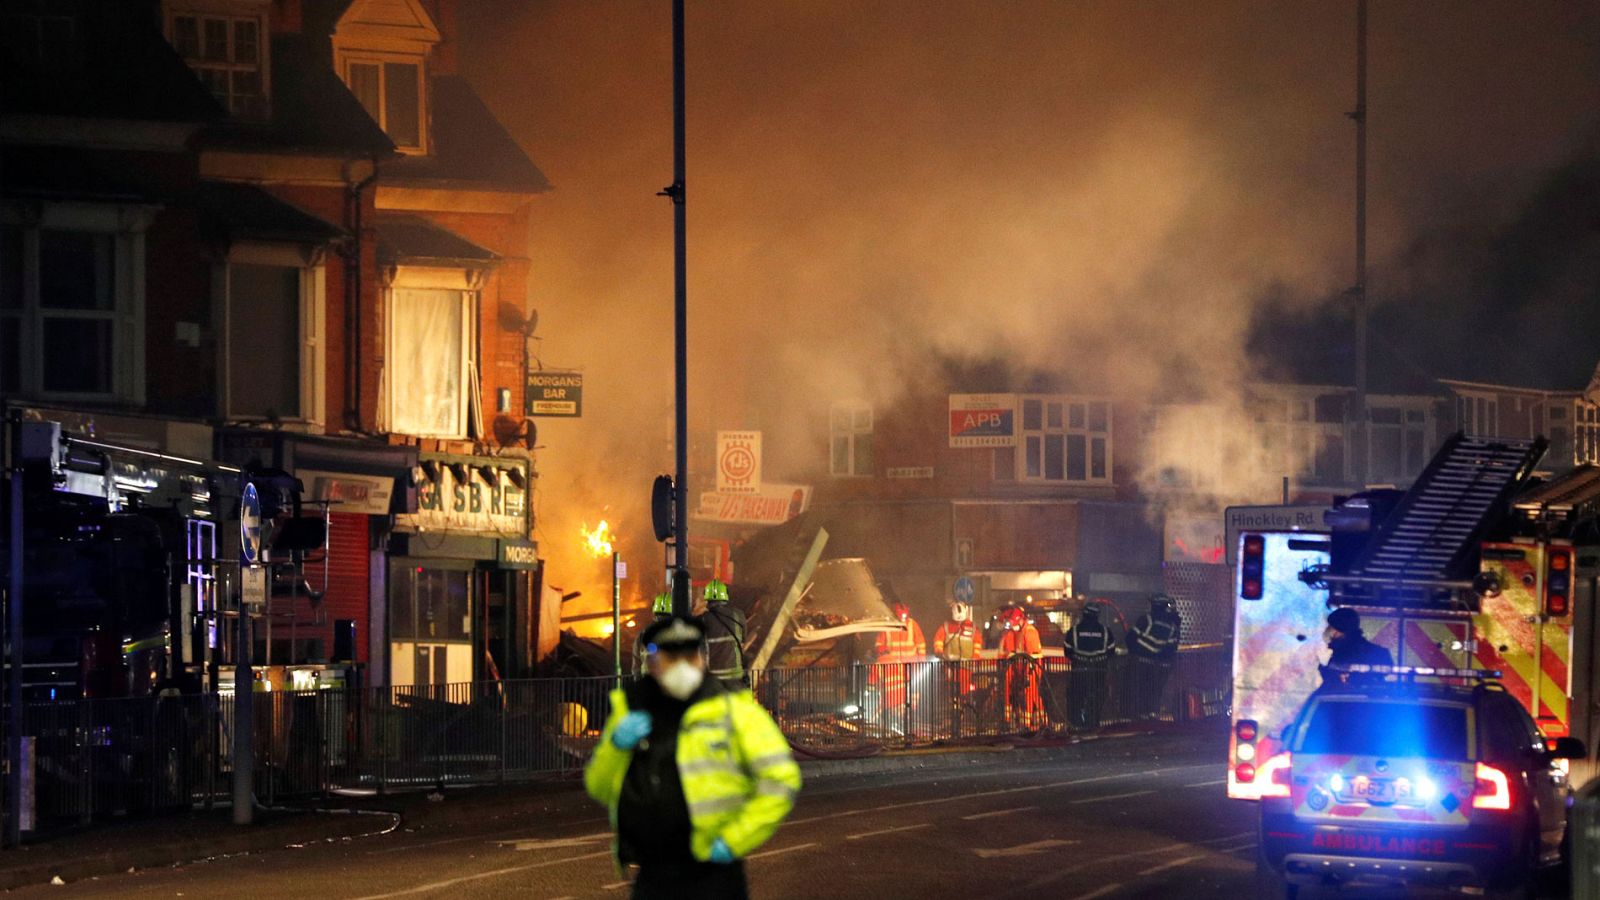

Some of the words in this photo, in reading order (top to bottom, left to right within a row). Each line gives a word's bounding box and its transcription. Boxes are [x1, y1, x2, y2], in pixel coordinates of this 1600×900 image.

[528, 376, 581, 386] MORGANS
[543, 388, 566, 399] BAR
[963, 412, 1002, 428] APB
[1231, 513, 1292, 527] Hinckley
[1312, 831, 1446, 856] AMBULANCE
